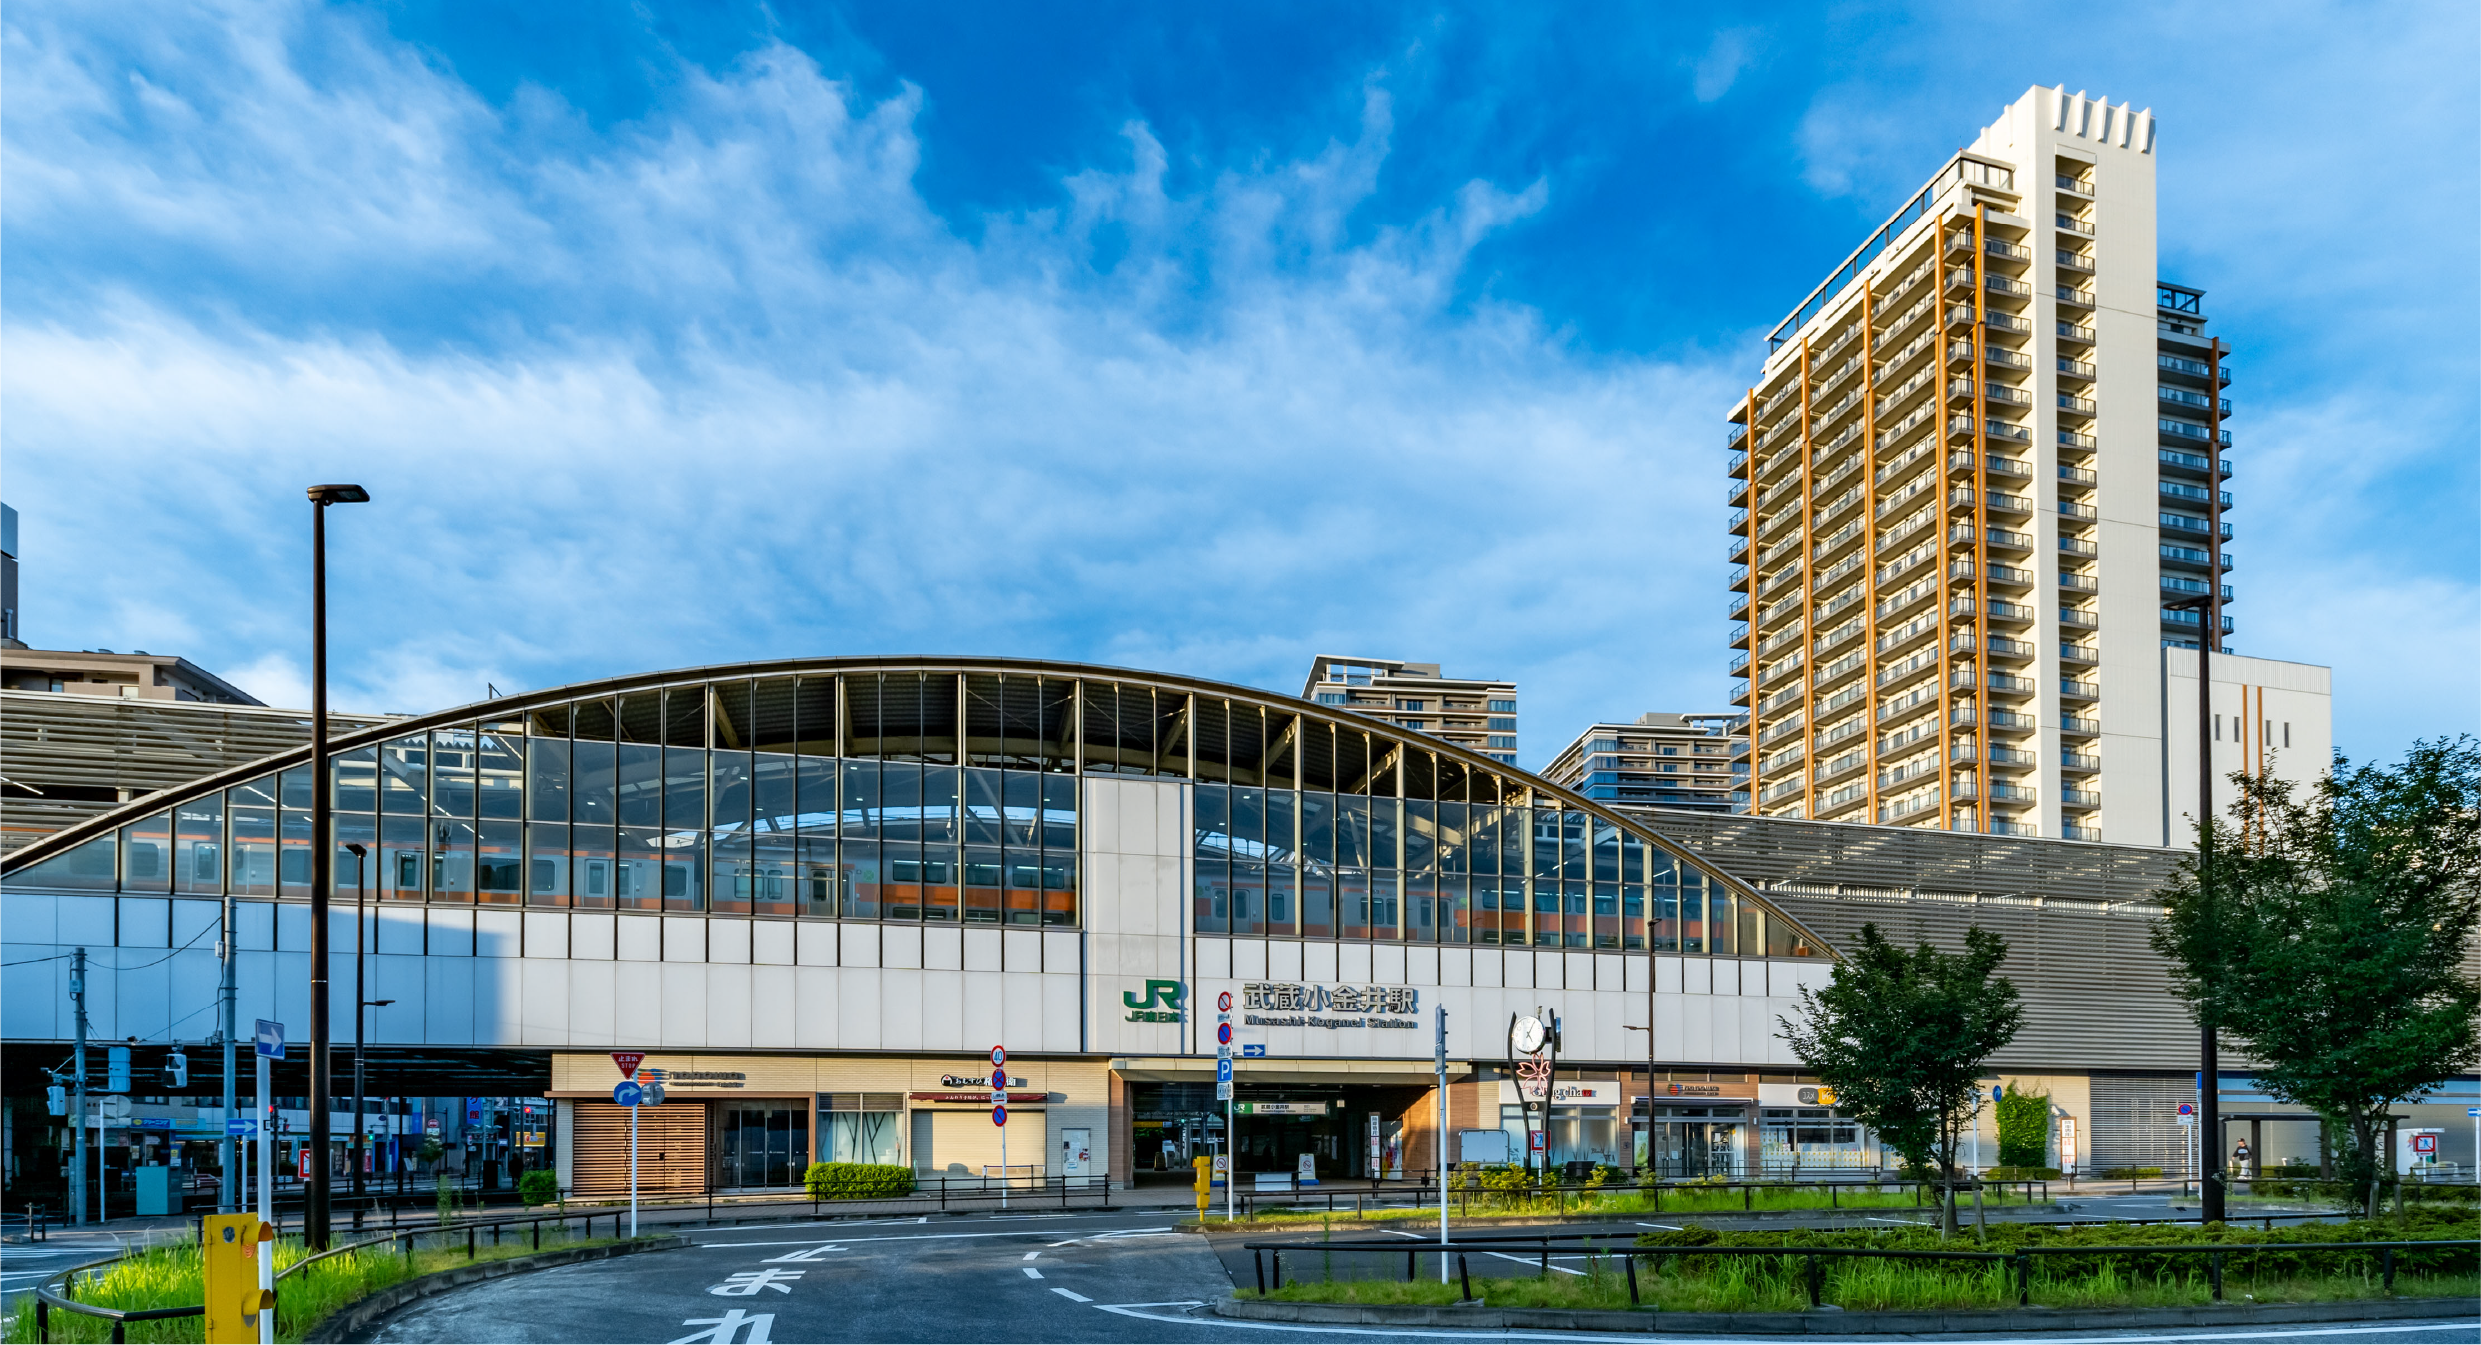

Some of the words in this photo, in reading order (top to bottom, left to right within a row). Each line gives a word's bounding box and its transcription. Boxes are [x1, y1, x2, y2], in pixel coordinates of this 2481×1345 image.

[1123, 979, 1180, 1010] JR
[1243, 983, 1415, 1013] 武蔵小金井駅
[1125, 1010, 1180, 1022] JR東日本
[1244, 1014, 1363, 1029] Musashi-Koganei
[1367, 1017, 1415, 1029] Station
[993, 1050, 1003, 1061] 40
[1221, 1061, 1230, 1080] P
[955, 1076, 1016, 1087] おむすび権衛
[1563, 1084, 1582, 1097] cha
